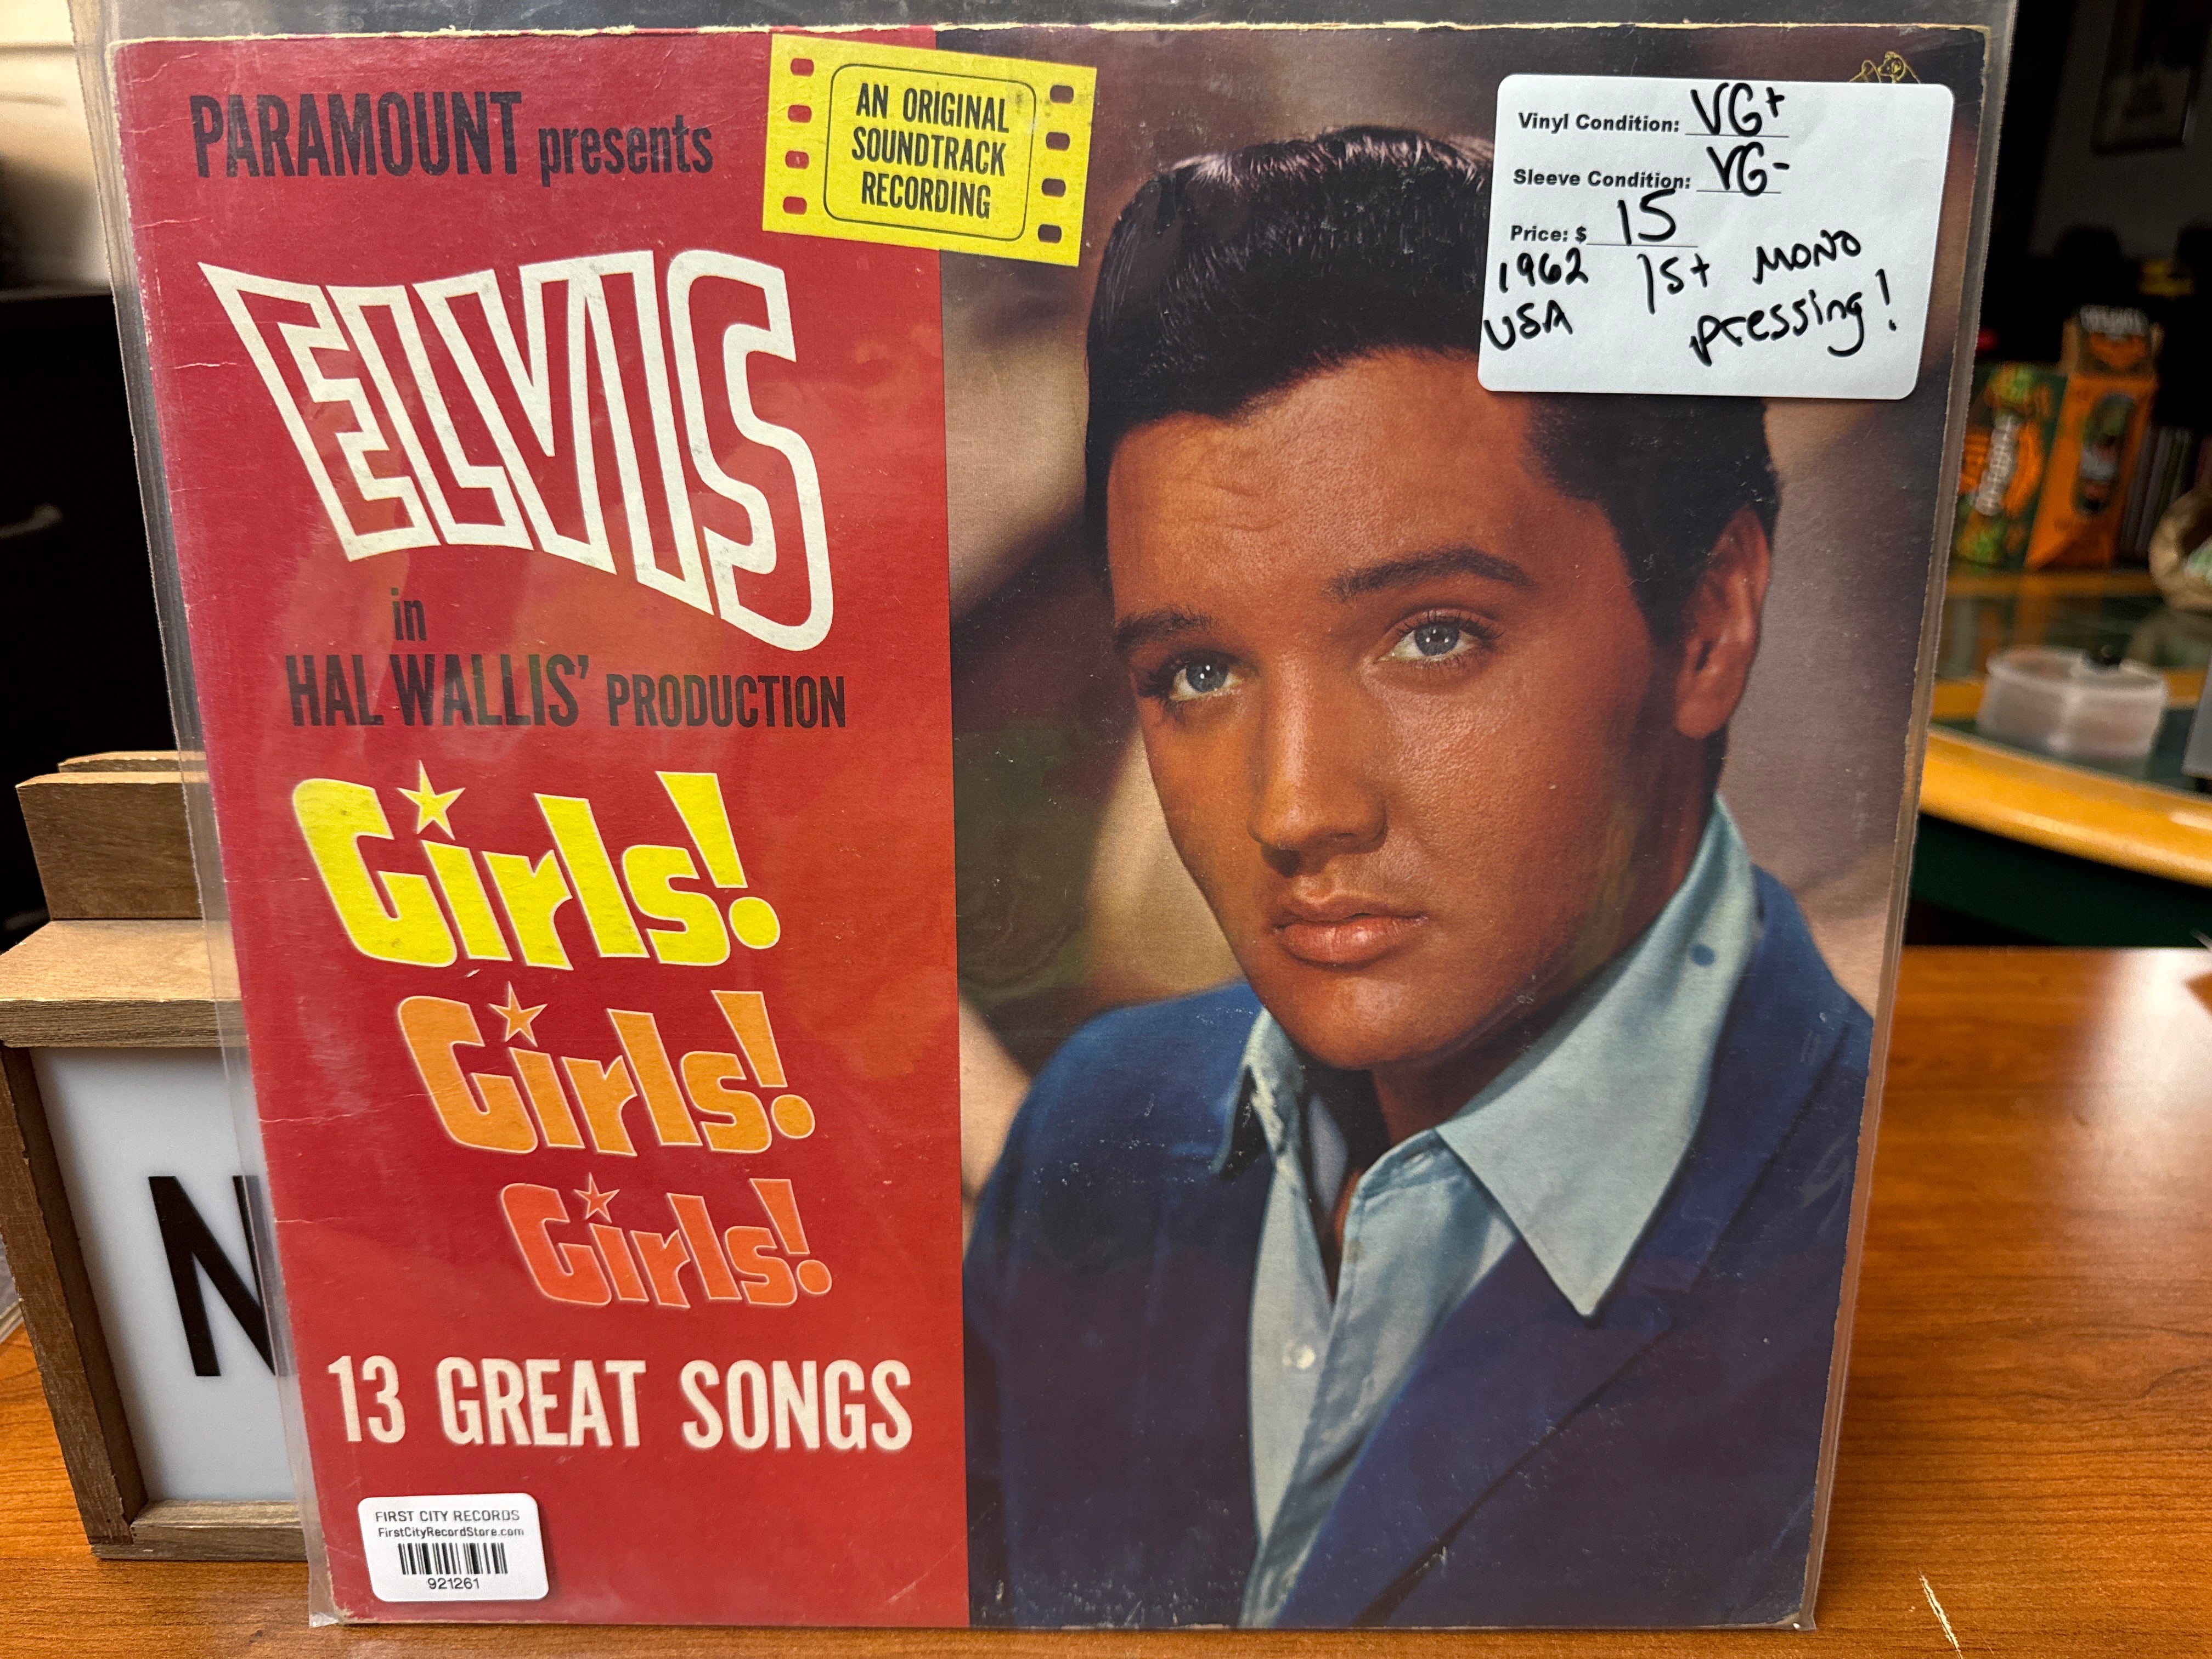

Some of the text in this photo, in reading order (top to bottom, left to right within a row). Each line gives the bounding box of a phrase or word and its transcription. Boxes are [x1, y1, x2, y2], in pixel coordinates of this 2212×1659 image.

[856, 82, 1008, 133] AN ORIGINAL
[1518, 82, 1785, 137] Vinyl Condition: VG+
[189, 91, 713, 188] PARAMOUNT presents
[851, 127, 1007, 176] SOUNDTRACK
[1513, 142, 1790, 196] Sleeve Condition: VG-
[862, 171, 991, 219] RECORDING
[1510, 225, 1567, 242] Price:
[1617, 188, 1676, 246] 15
[1499, 247, 1588, 293] 1962
[1637, 253, 1711, 314] 1st
[1483, 269, 1897, 366] USA pressing!
[198, 250, 834, 651] ELVIS
[391, 587, 426, 641] in
[286, 654, 845, 728] HAL WALLIS' PRODUCTION
[292, 760, 780, 970] Girls!
[397, 981, 815, 1156] Girls!
[500, 1171, 832, 1308] Girls!
[149, 1176, 289, 1376] N
[328, 1355, 912, 1451] 13 GREAT SONGS
[375, 1510, 520, 1522] FIRST CITY RECORDS
[379, 1527, 524, 1539] FirstCityRecordStore.com
[427, 1578, 479, 1589] 921261
